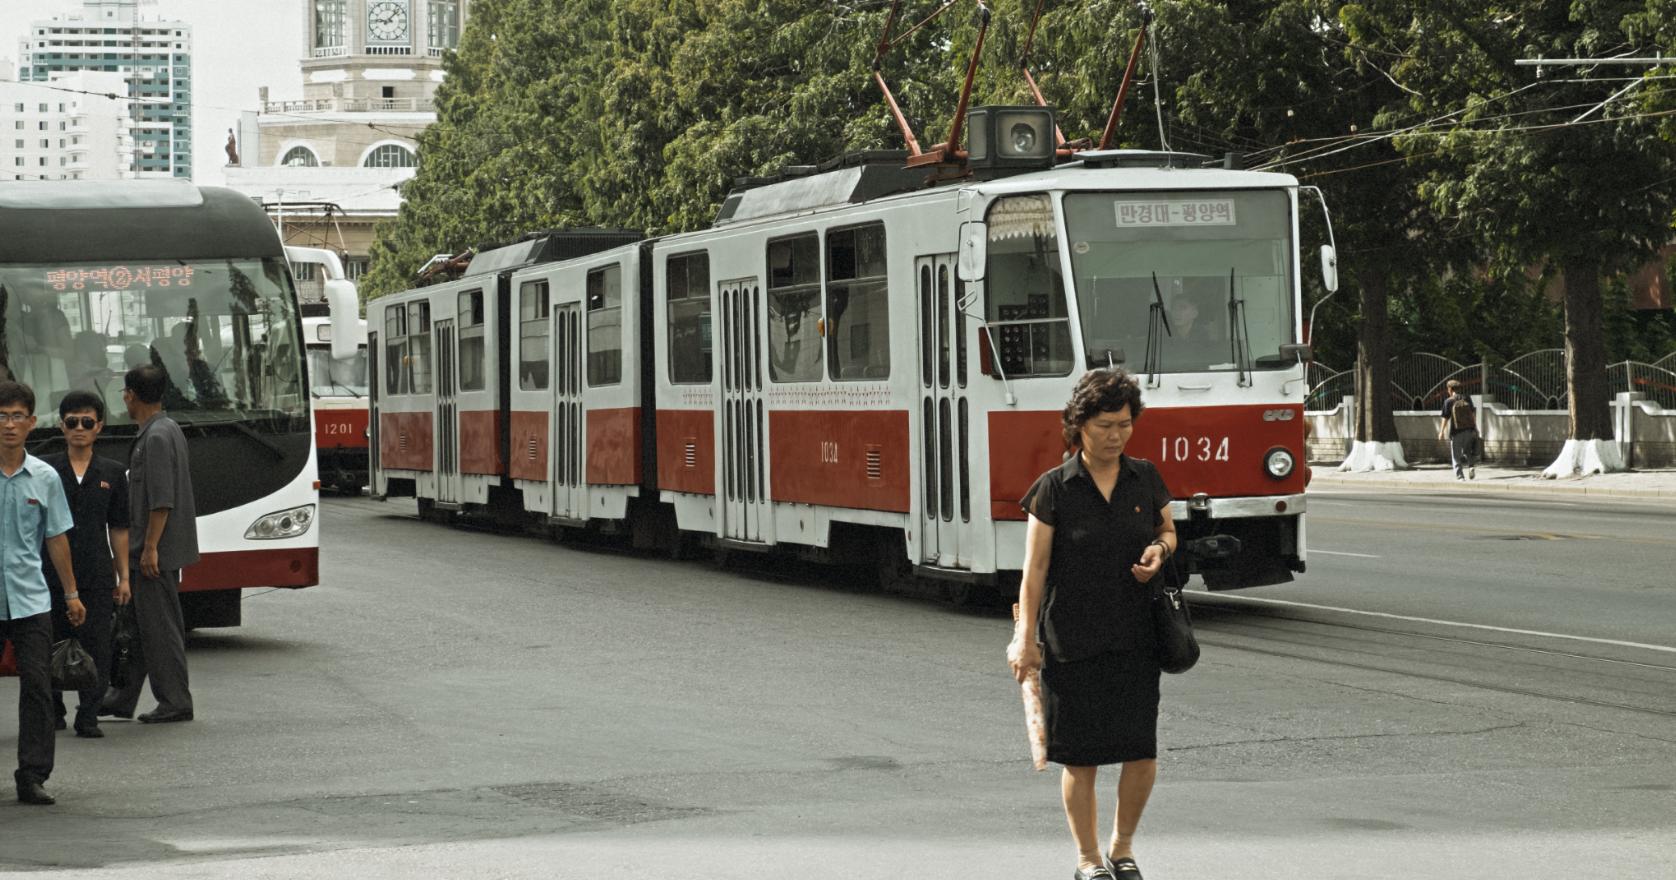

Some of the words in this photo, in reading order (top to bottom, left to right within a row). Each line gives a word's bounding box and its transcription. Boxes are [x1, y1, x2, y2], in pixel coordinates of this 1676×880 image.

[1120, 202, 1231, 224] 만경대-평양역
[325, 423, 352, 435] 1201
[821, 441, 838, 463] 1034
[1162, 437, 1229, 462] 1034
